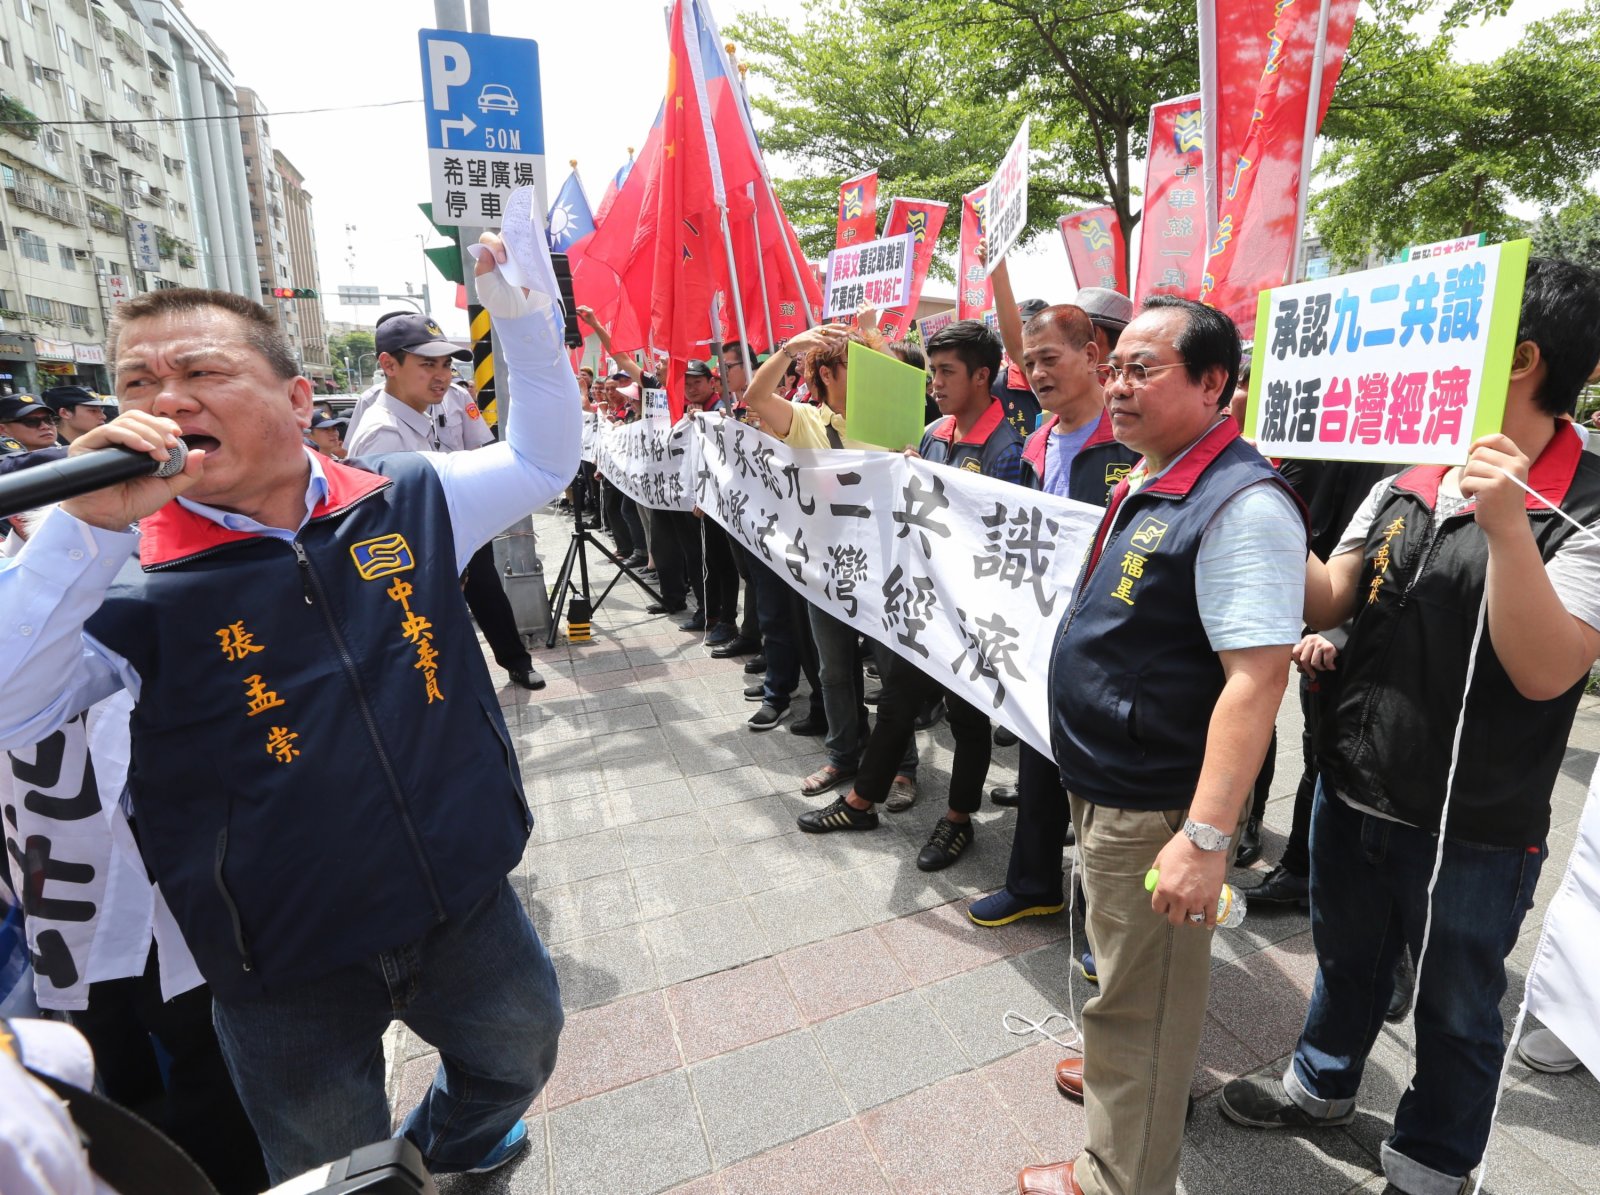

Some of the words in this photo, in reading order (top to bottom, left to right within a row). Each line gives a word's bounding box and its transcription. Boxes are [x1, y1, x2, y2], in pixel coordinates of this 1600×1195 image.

[428, 39, 471, 111] P
[485, 128, 521, 150] 50M
[444, 157, 534, 188] 希望廣場
[445, 190, 502, 219] 停車
[833, 240, 906, 282] 蔡英文要記取教訓
[842, 227, 857, 242] 中
[830, 276, 903, 312] 不要成為無恥裕仁
[1271, 260, 1486, 361] 承認九二共識
[1261, 365, 1472, 445] 激活台灣經濟
[697, 415, 1059, 618] 只有承認九二共識
[695, 459, 1027, 709] 才能激活台灣經濟
[1110, 550, 1149, 606] 福星
[386, 576, 445, 704] 中央委員
[215, 619, 301, 763] 張孟崇
